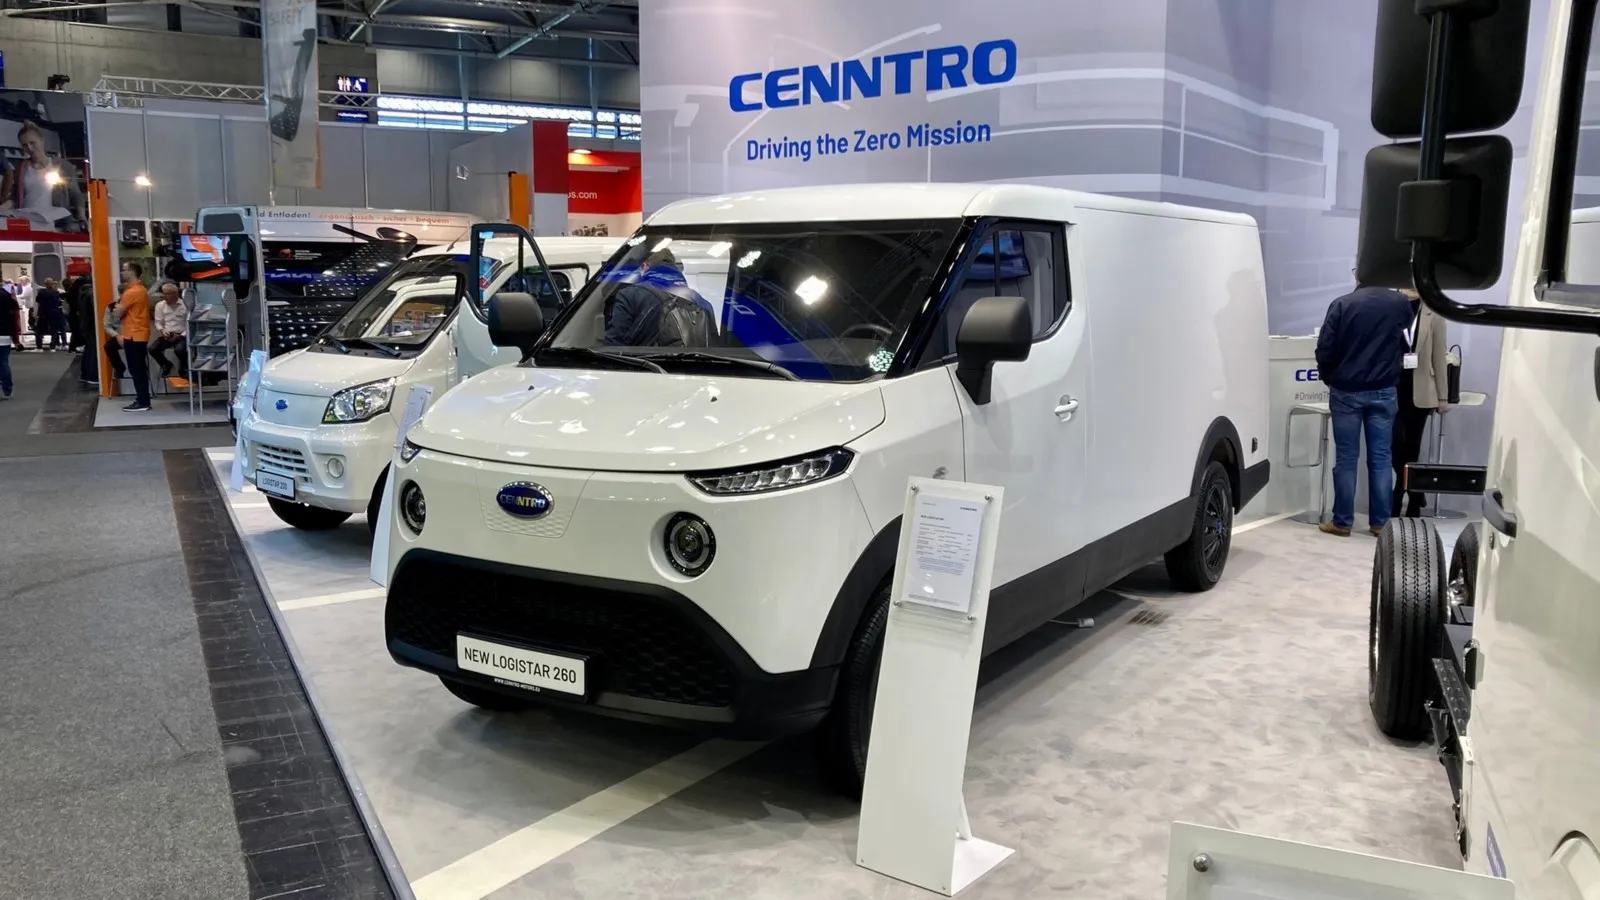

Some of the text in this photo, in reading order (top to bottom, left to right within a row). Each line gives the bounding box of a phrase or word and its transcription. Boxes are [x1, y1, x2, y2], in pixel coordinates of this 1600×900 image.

[728, 38, 1018, 113] CENNTRO
[746, 120, 991, 162] Driving the Zero Mission
[1295, 369, 1319, 381] CE
[499, 494, 546, 508] CENNTRO
[464, 647, 577, 683] NEW LOGISTAR 260
